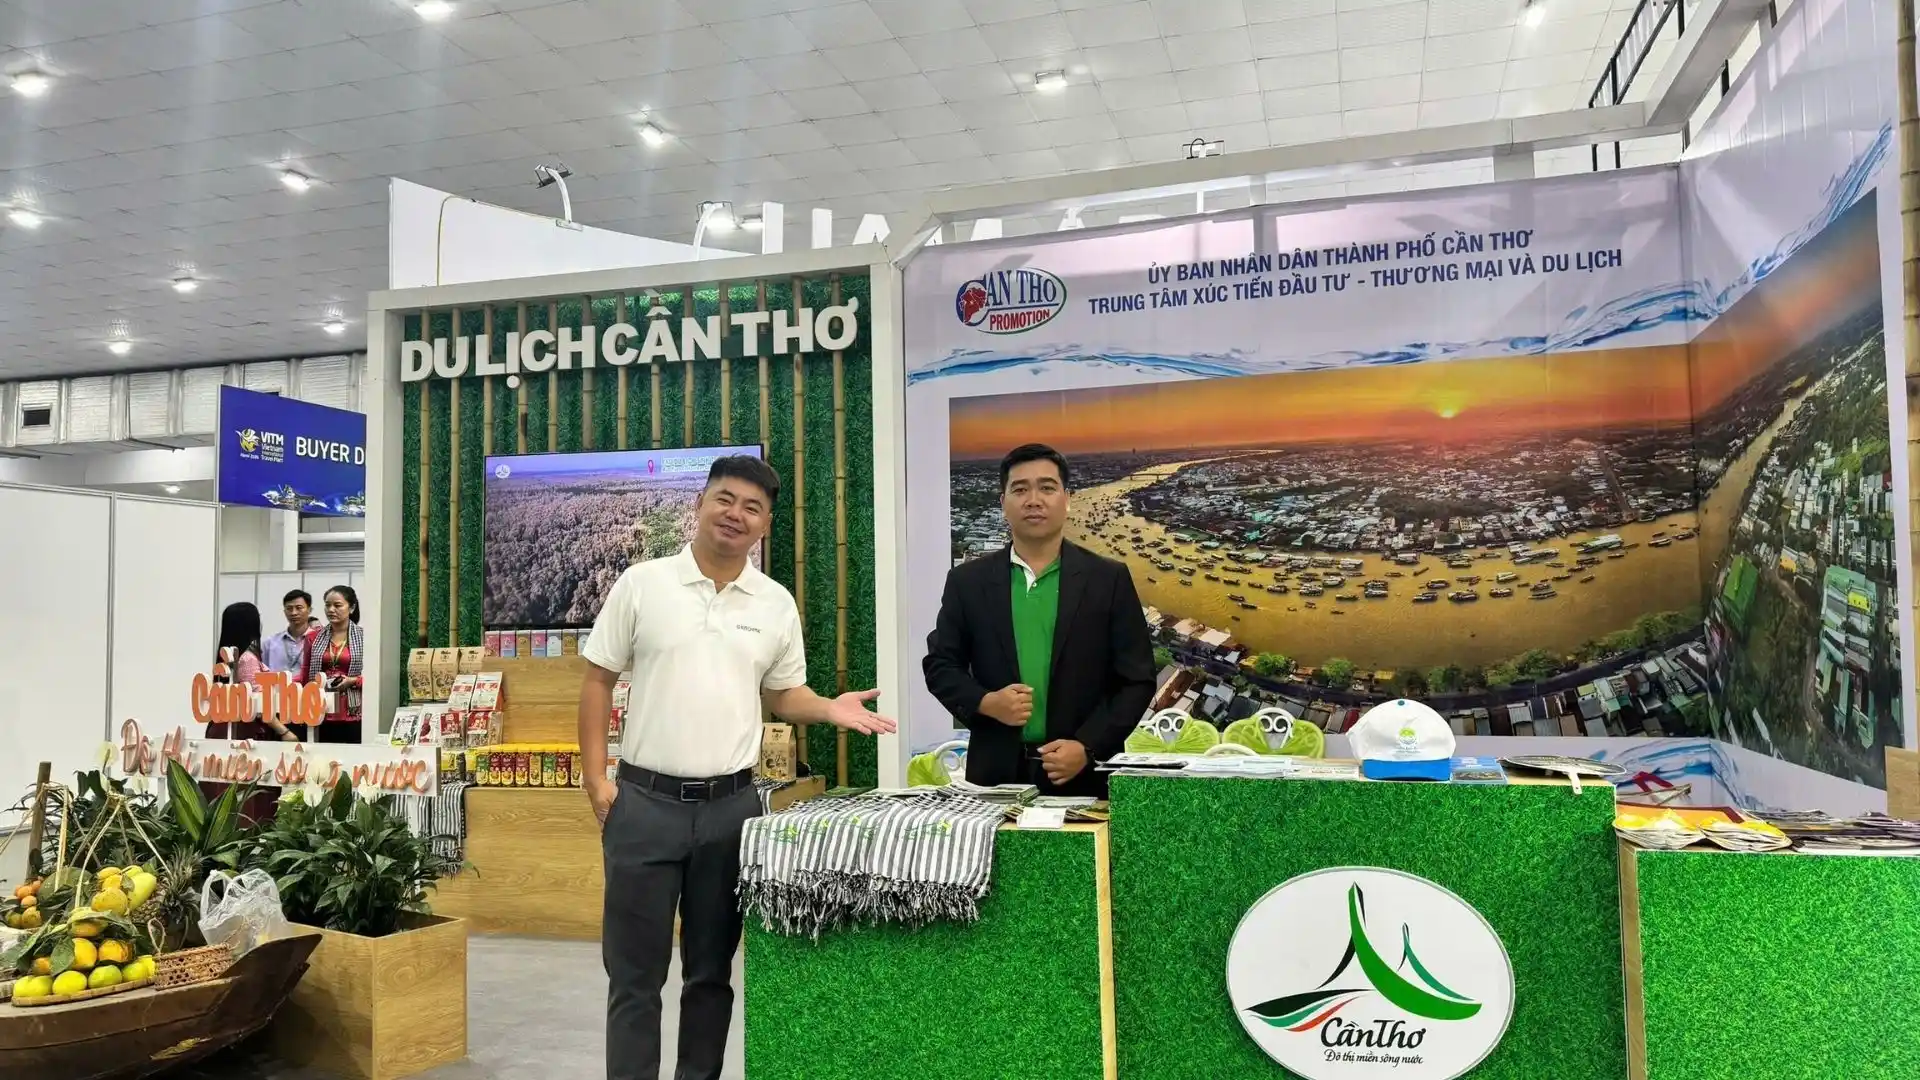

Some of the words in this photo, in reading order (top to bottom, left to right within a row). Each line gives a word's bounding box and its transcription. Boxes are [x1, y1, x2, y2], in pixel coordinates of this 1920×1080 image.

[1148, 261, 1171, 284] ỦY
[1177, 261, 1214, 281] BAN
[1220, 253, 1272, 276] NHÂN
[1278, 248, 1318, 270] DÂN
[1323, 242, 1389, 266] THÀNH
[1395, 232, 1436, 260] PHỐ
[1442, 230, 1484, 255] CẦN
[1489, 229, 1534, 251] THƠ
[1088, 294, 1145, 314] TRUNG
[1149, 287, 1188, 309] TÂM
[1193, 283, 1228, 304] XÚC
[1233, 275, 1273, 300] TIẾN
[1278, 272, 1317, 296] ĐẦU
[1322, 273, 1351, 292] TƯ
[1370, 262, 1459, 287] THƯƠNG
[1465, 259, 1503, 281] MẠI
[1508, 252, 1536, 276] VÀ
[1542, 253, 1569, 273] DU
[1576, 249, 1622, 273] LỊCH
[401, 335, 470, 382] DU
[475, 325, 596, 389] LỊCH
[601, 288, 722, 366] CẦN
[730, 296, 859, 357] THƠ
[989, 309, 1051, 331] PROMOTION
[260, 431, 284, 446] VITM
[296, 436, 350, 463] BUYER
[191, 646, 254, 723] Cần
[255, 671, 327, 727] Thơ
[1324, 1048, 1341, 1061] Đô
[1342, 1050, 1355, 1063] thị
[1356, 1050, 1378, 1063] miền
[1380, 1053, 1400, 1068] sông
[1401, 1054, 1423, 1064] nước
